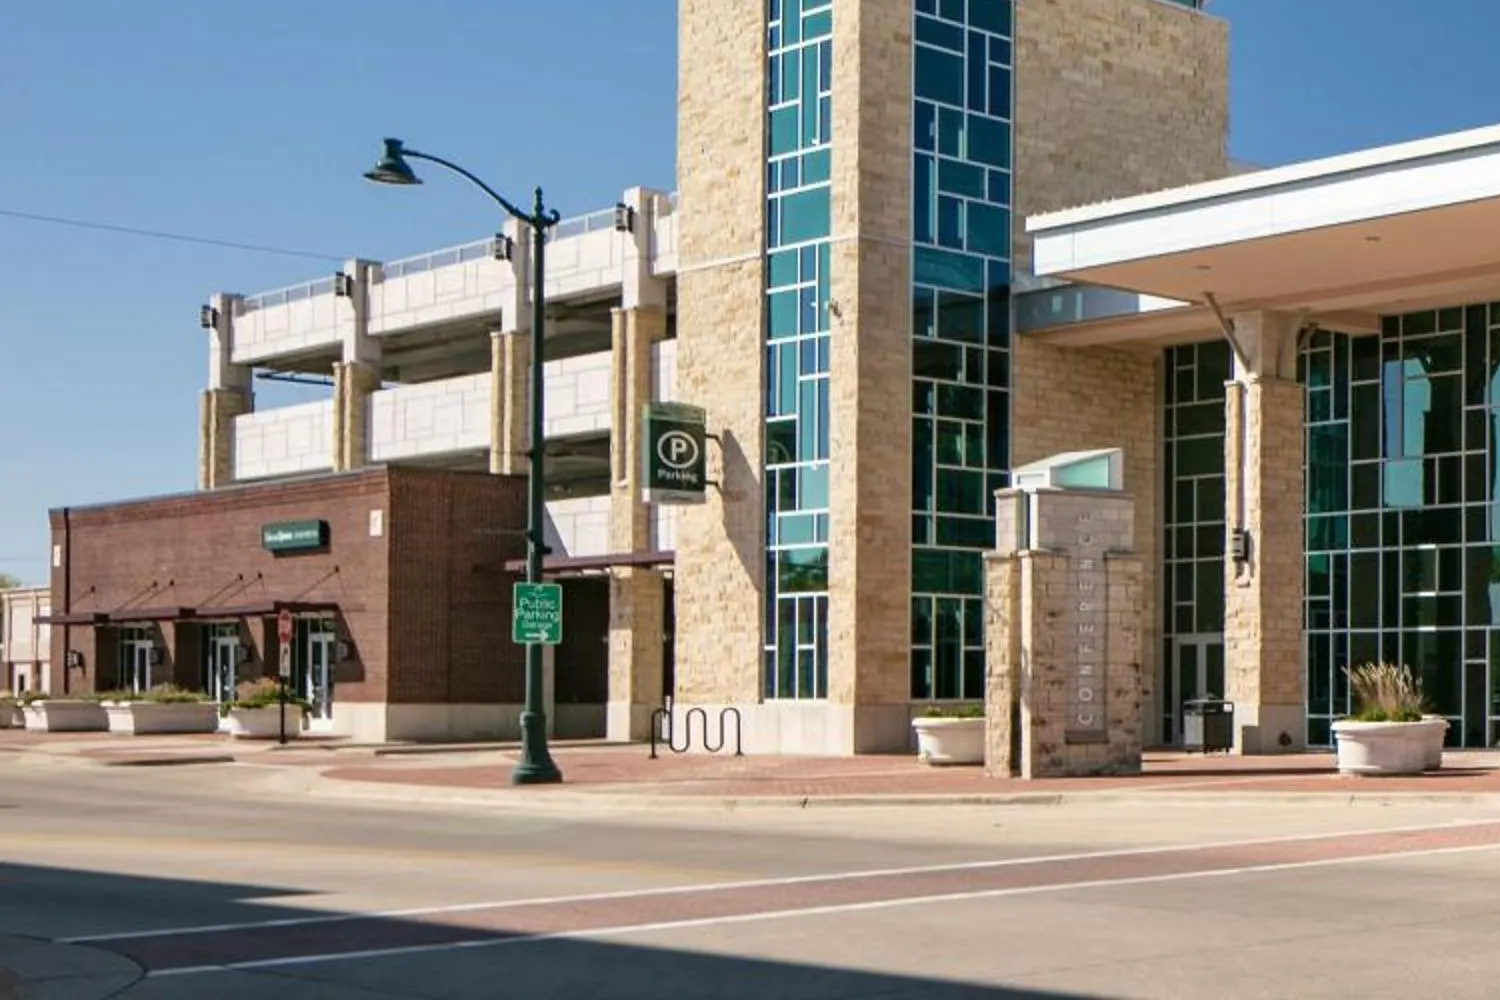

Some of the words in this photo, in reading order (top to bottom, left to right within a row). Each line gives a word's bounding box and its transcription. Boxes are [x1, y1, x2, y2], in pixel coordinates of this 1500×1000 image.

[657, 468, 698, 484] Parking
[519, 597, 556, 610] Public
[515, 608, 560, 622] Parking
[1078, 513, 1093, 726] CONFERENCE
